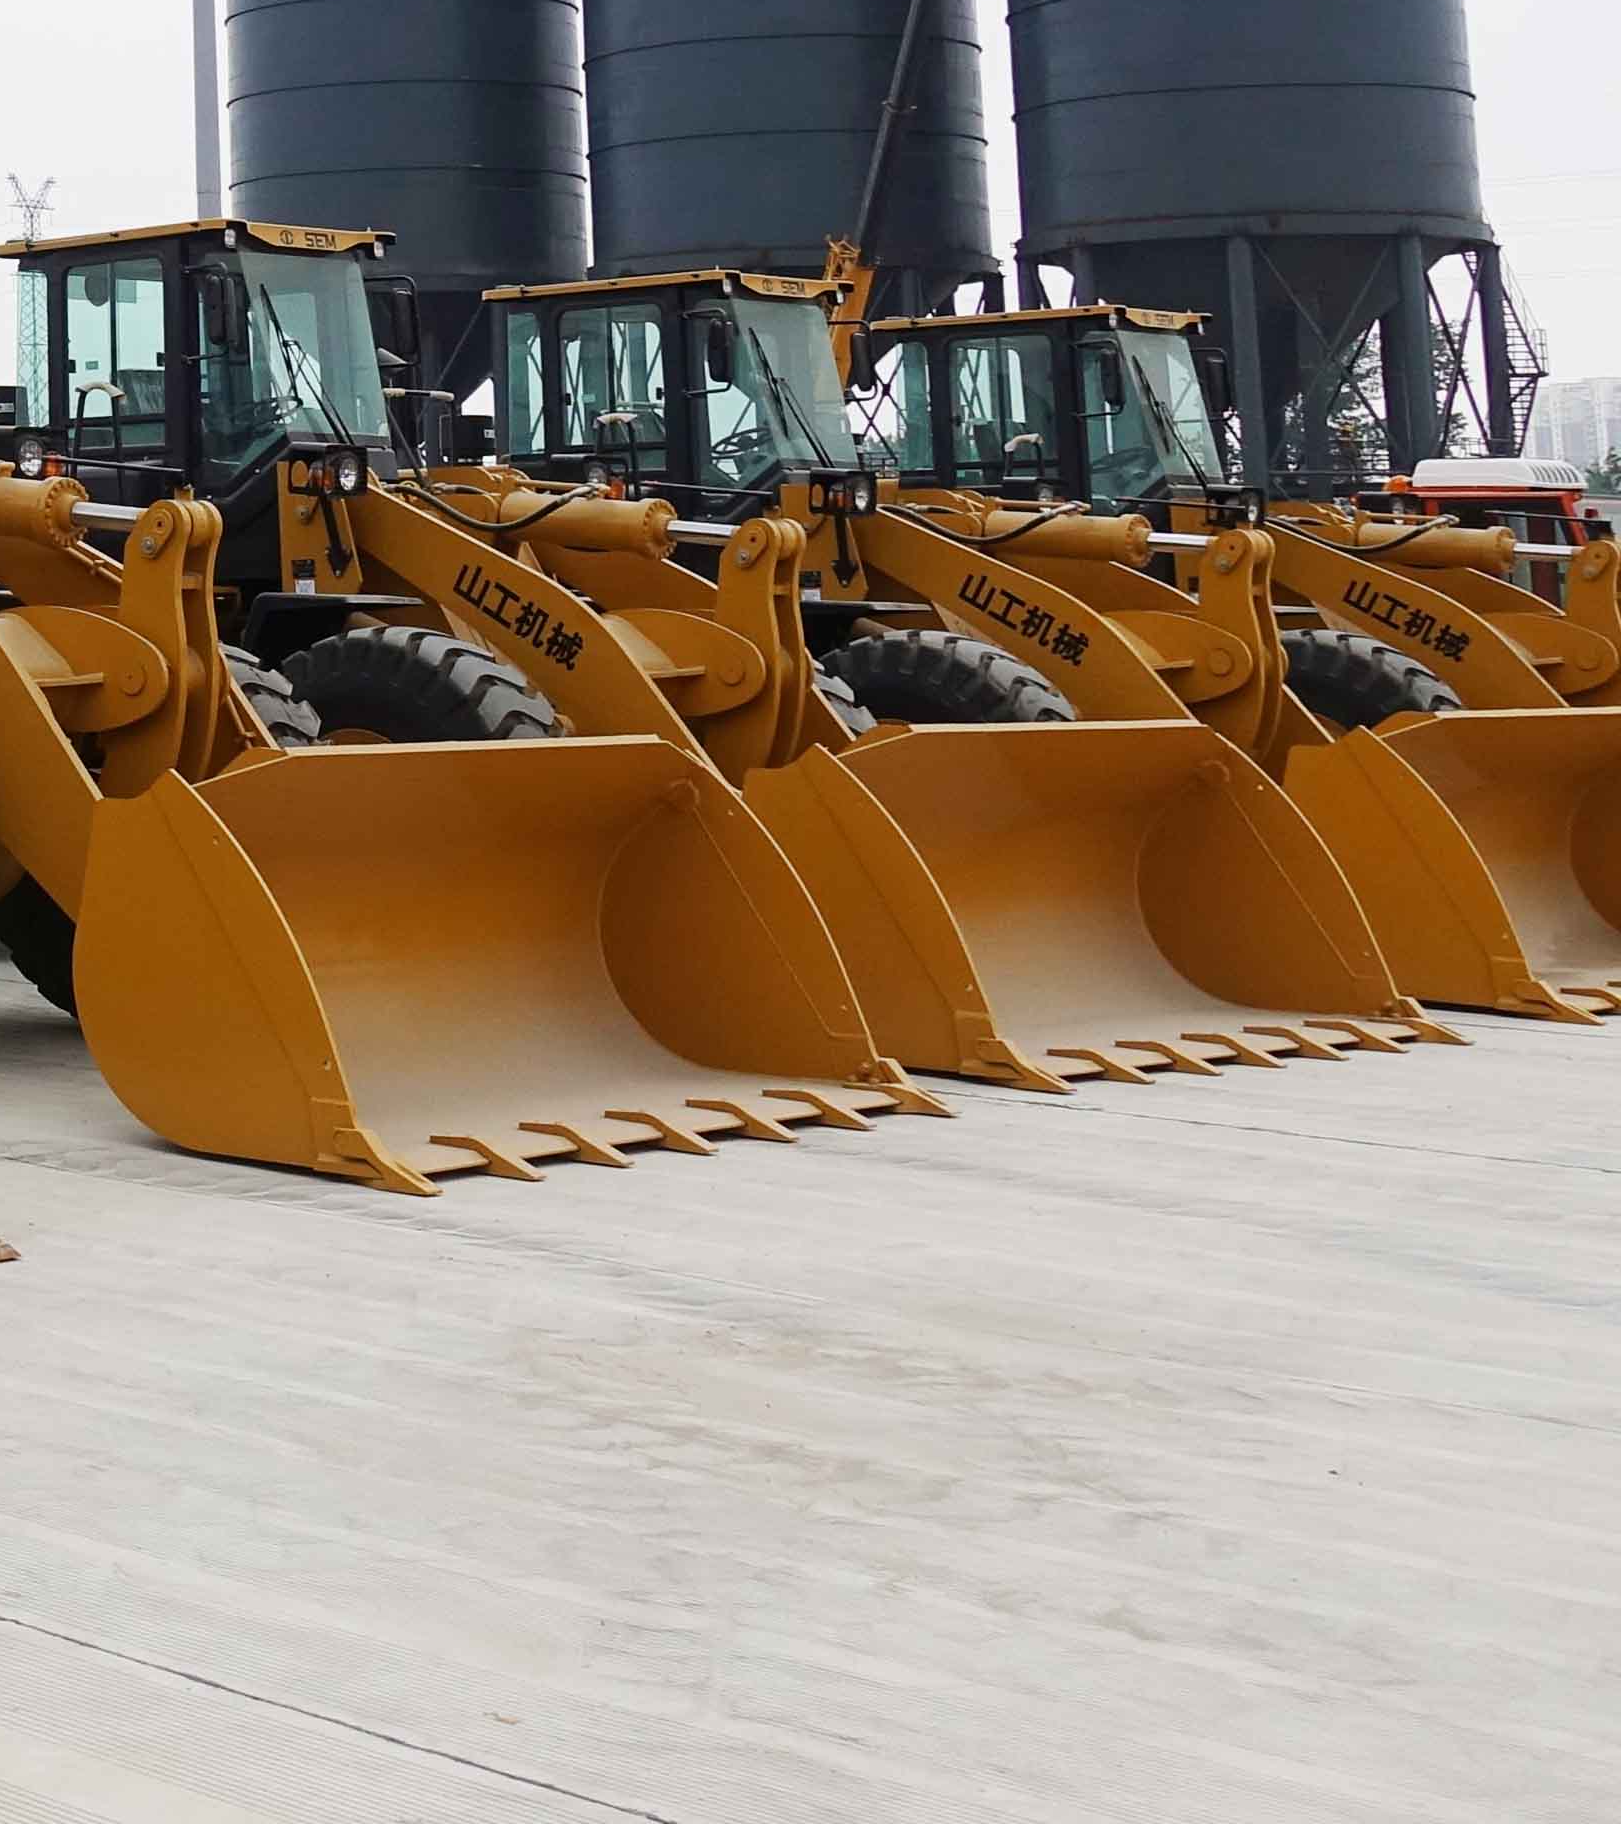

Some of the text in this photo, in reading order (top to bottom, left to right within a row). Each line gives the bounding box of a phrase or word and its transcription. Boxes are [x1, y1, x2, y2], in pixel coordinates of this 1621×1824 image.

[304, 232, 337, 249] SEM
[453, 564, 583, 671] 山工机械
[959, 574, 1089, 667] 山工机械
[1342, 580, 1470, 662] 山工机械
